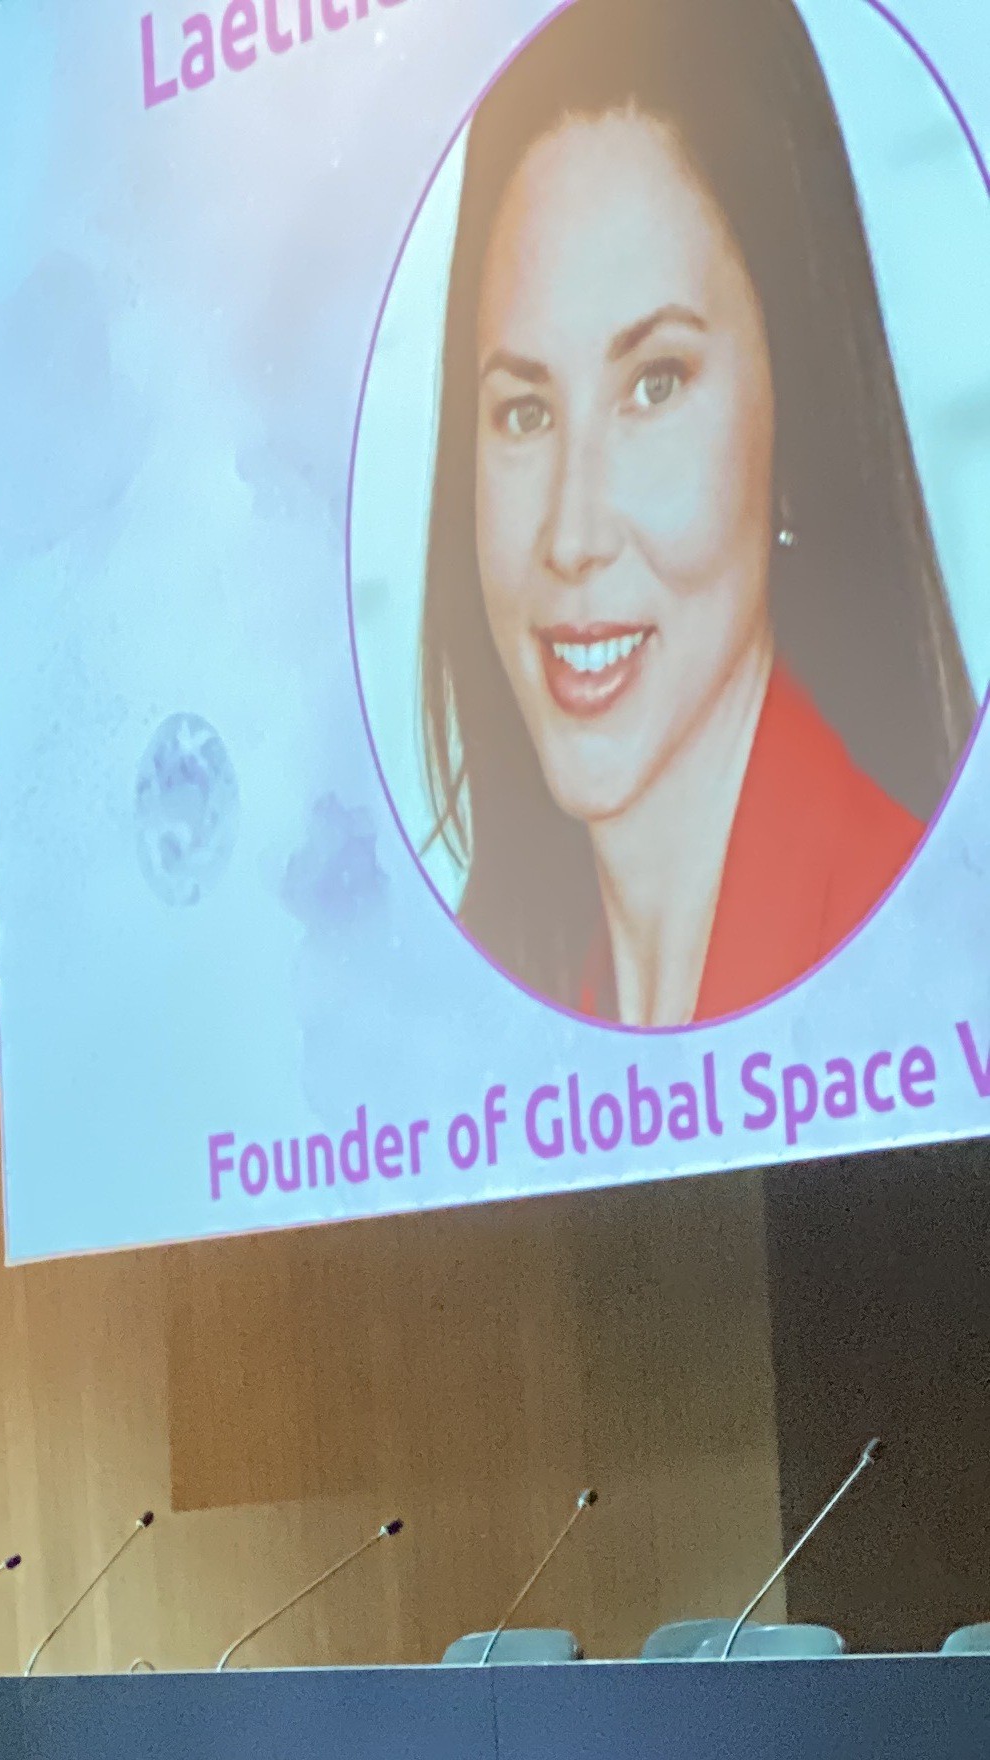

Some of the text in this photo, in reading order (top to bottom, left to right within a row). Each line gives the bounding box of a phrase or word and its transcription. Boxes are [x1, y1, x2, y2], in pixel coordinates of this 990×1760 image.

[208, 1103, 430, 1201] Founder
[447, 1084, 507, 1170] of
[525, 1050, 723, 1159] Global
[740, 1045, 936, 1145] Space
